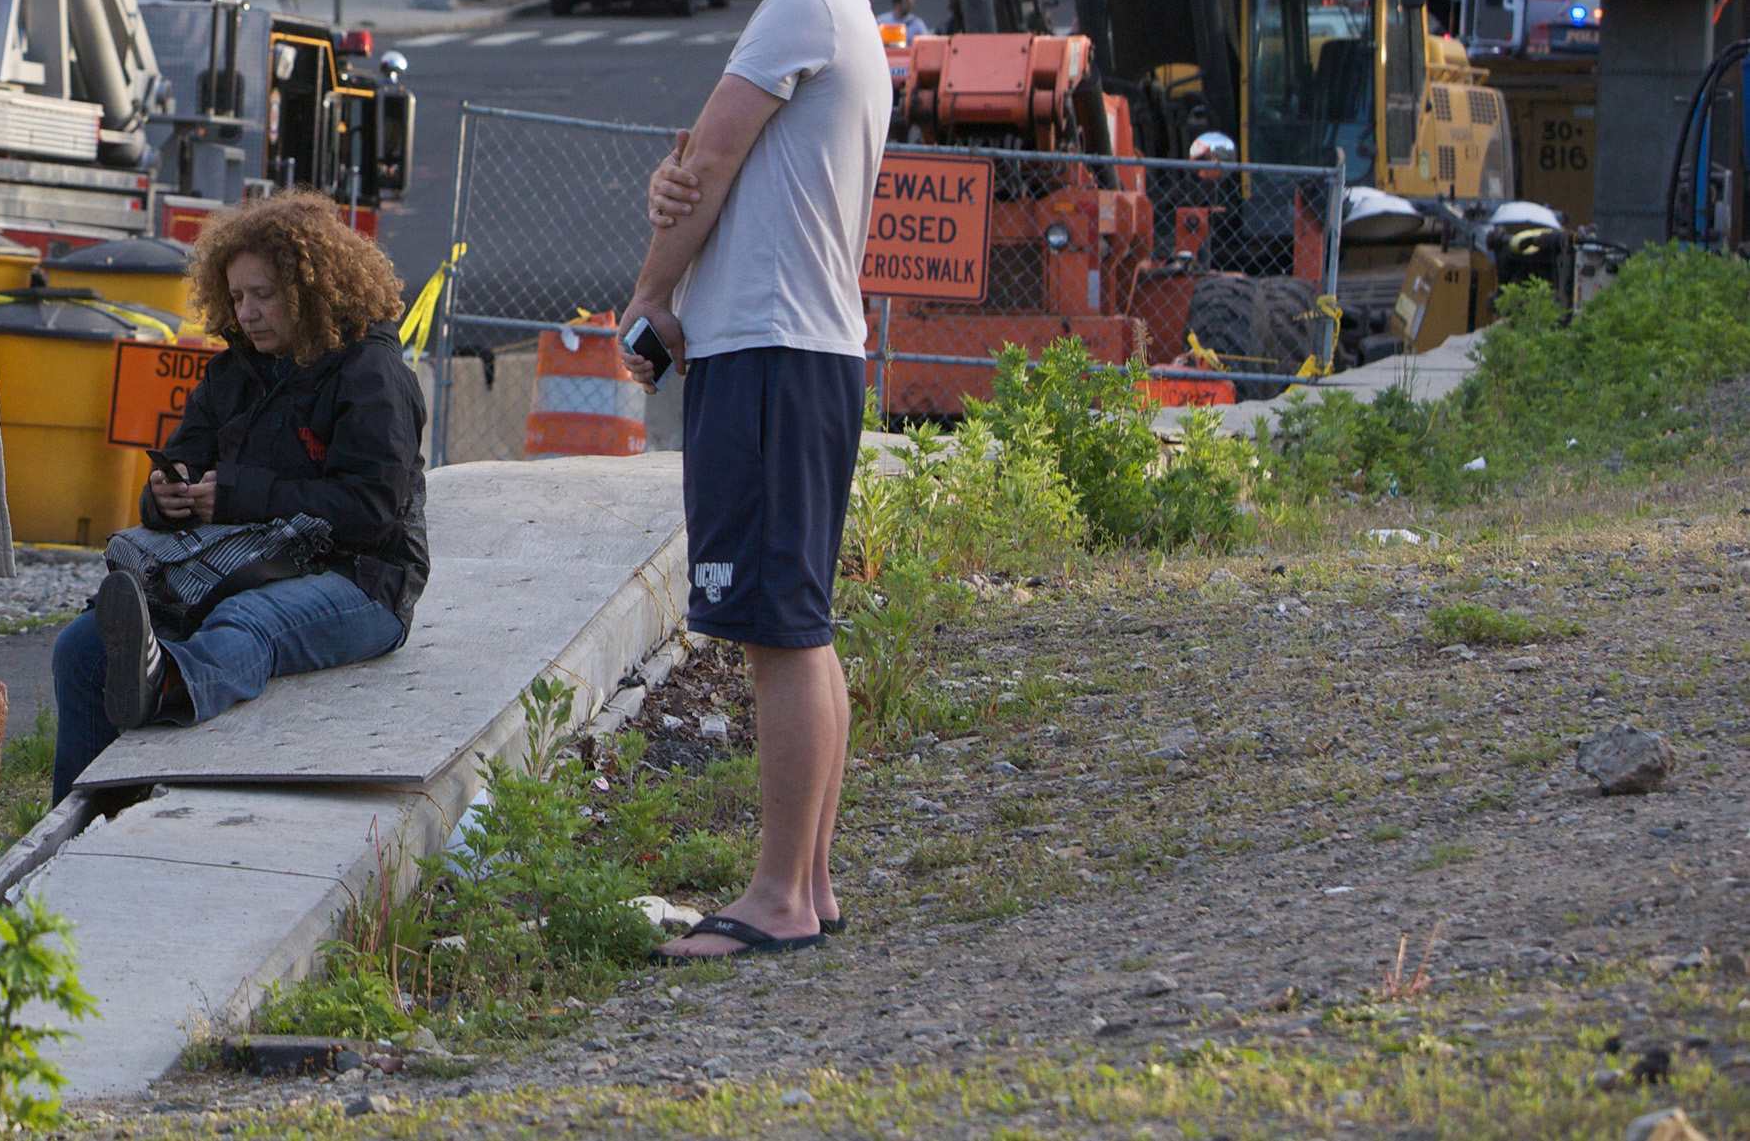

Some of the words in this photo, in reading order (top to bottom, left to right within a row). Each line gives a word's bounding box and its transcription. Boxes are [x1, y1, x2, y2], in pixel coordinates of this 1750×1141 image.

[1539, 144, 1588, 171] 816
[862, 253, 975, 284] CROSSWALK
[694, 562, 734, 588] UCONN
